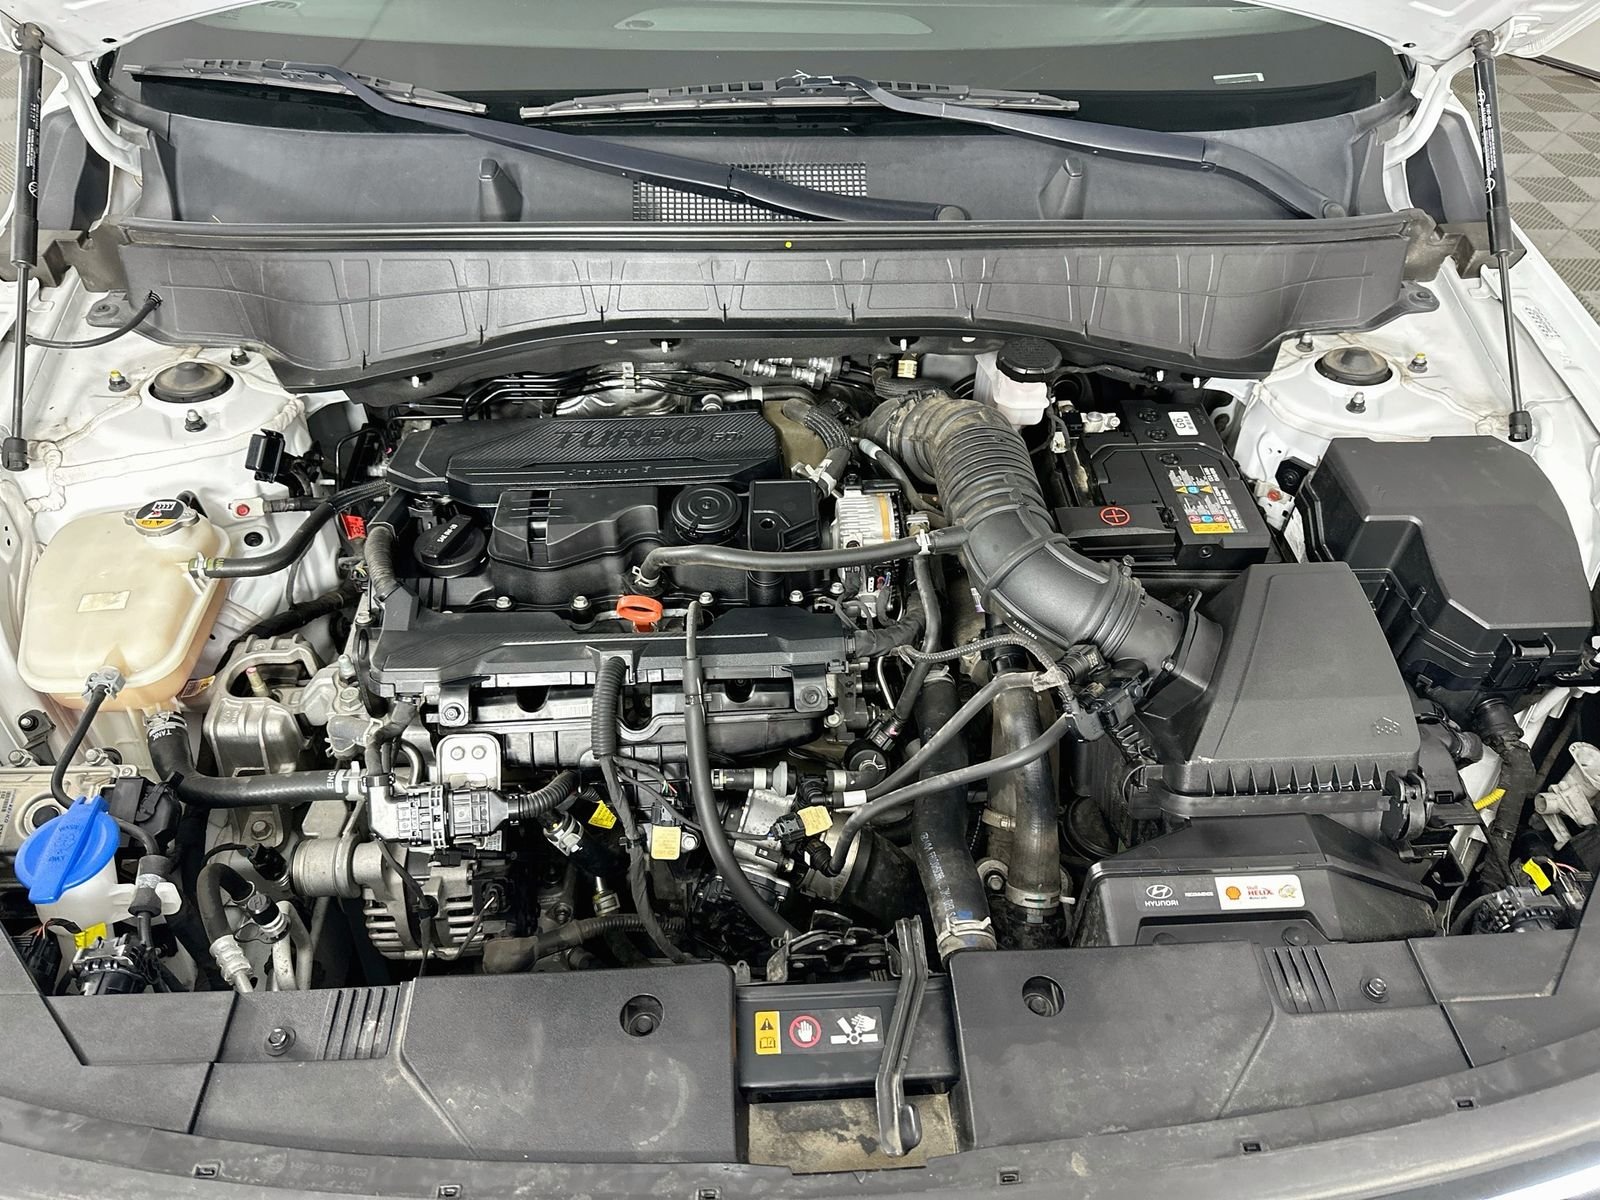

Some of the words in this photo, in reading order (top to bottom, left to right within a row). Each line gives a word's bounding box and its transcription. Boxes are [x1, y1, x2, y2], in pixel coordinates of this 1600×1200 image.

[554, 426, 704, 449] TURBO
[152, 729, 173, 741] TANK
[1247, 887, 1275, 896] HELIX
[1144, 899, 1180, 908] HYUNDAI
